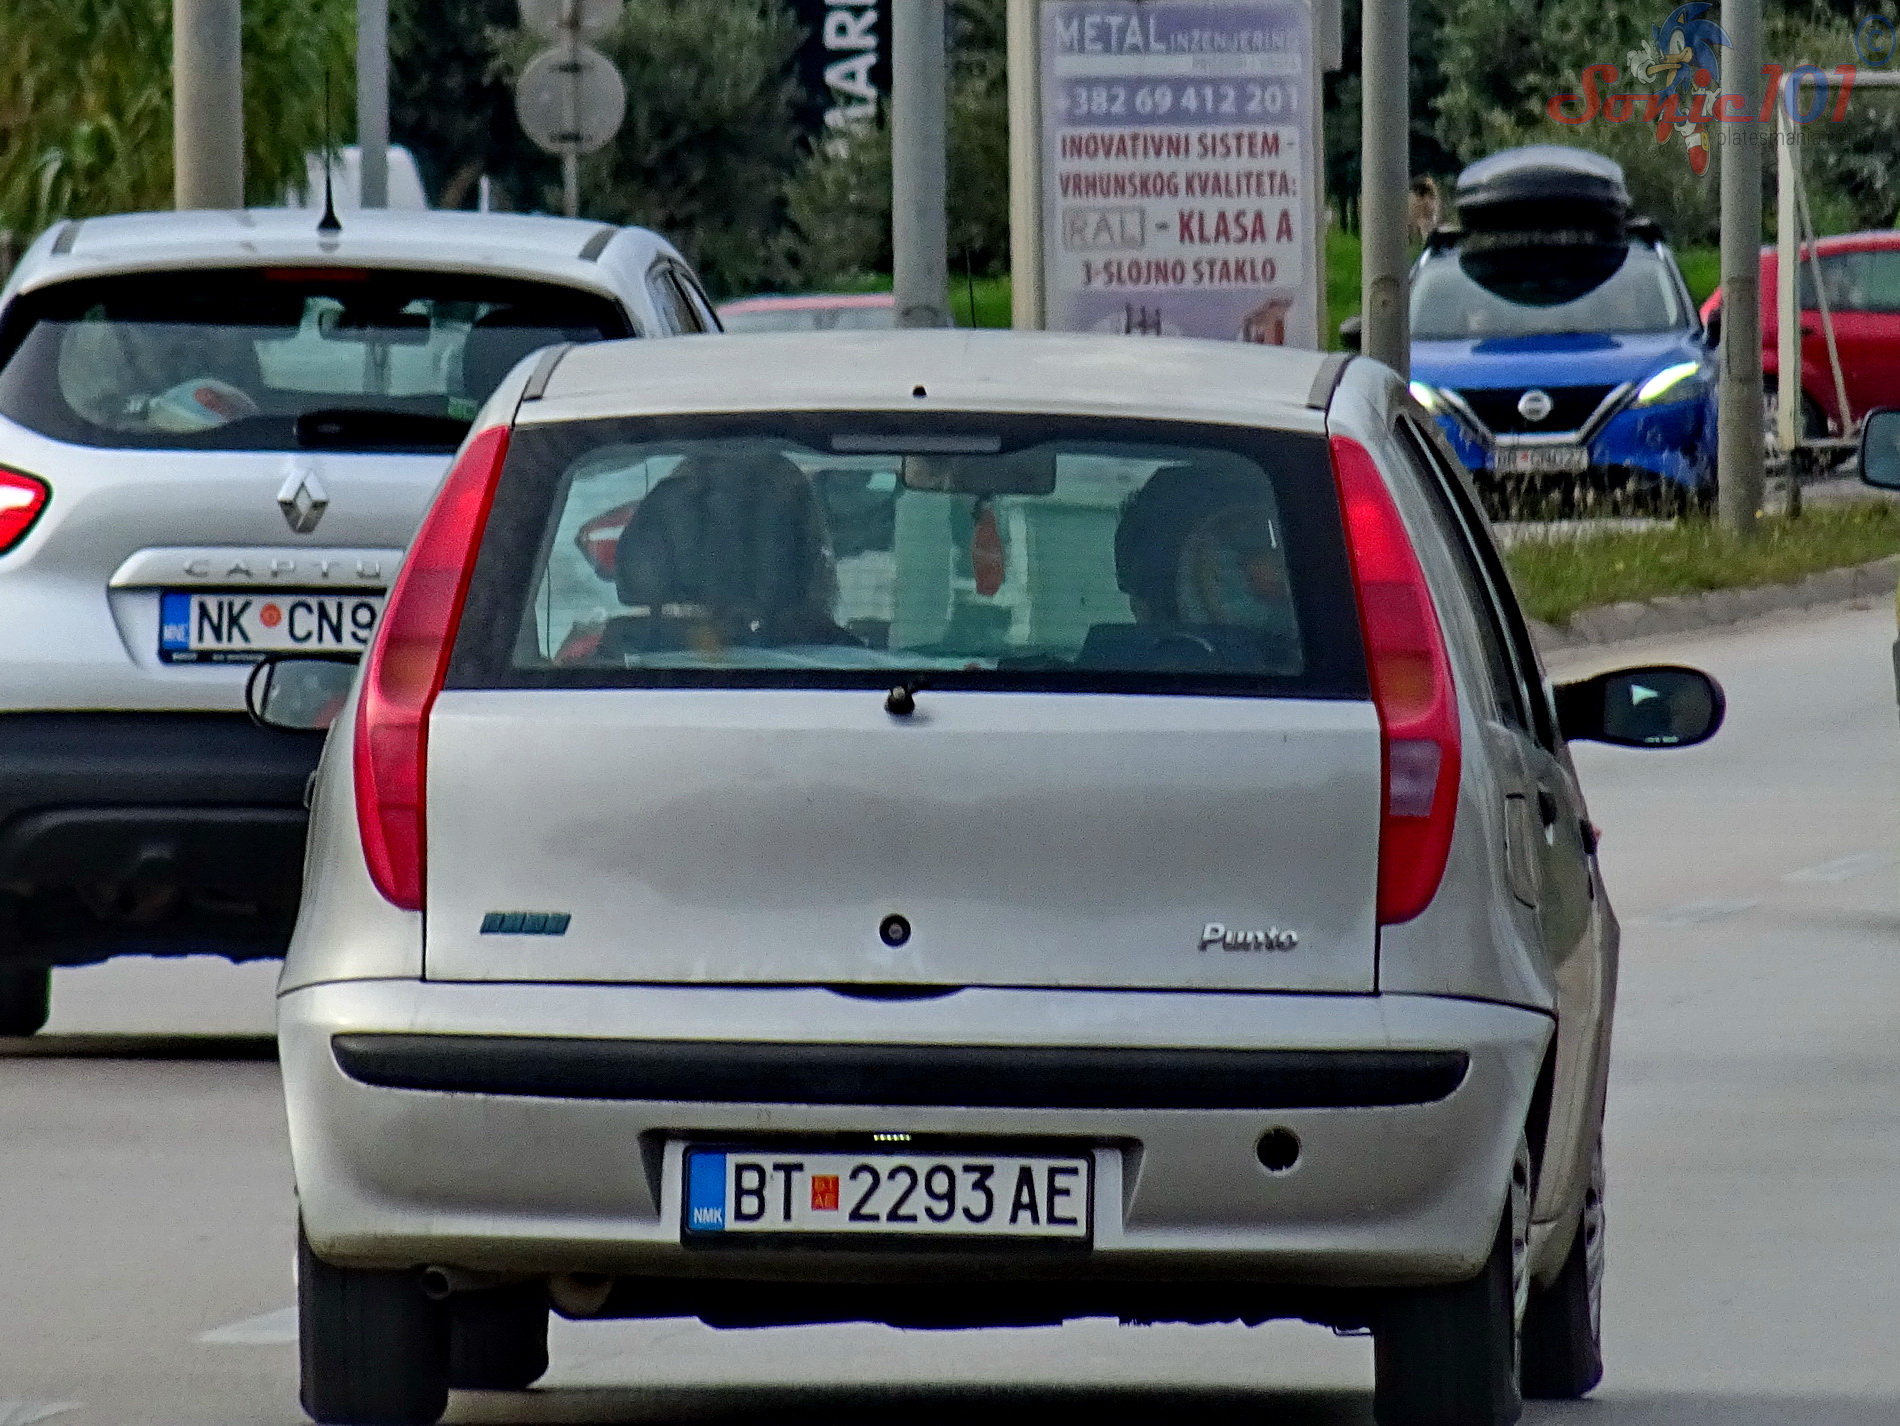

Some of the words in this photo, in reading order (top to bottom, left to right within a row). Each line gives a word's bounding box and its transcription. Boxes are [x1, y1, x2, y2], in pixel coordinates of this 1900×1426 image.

[1054, 15, 1166, 53] METAL
[1134, 84, 1173, 115] 69
[1180, 84, 1237, 116] 412
[1060, 132, 1190, 160] INOVATIVNI
[1197, 131, 1280, 160] SISTEM
[1059, 171, 1180, 198] VRHUNSKOG
[1178, 208, 1266, 245] KLASA
[1276, 208, 1294, 244] A
[1193, 257, 1277, 286] STAKLO
[197, 600, 252, 644] NK
[1198, 922, 1298, 952] Punto
[732, 1162, 804, 1222] BT
[847, 1164, 995, 1224] 2293
[1009, 1166, 1079, 1225] AE
[693, 1207, 723, 1225] NMK
